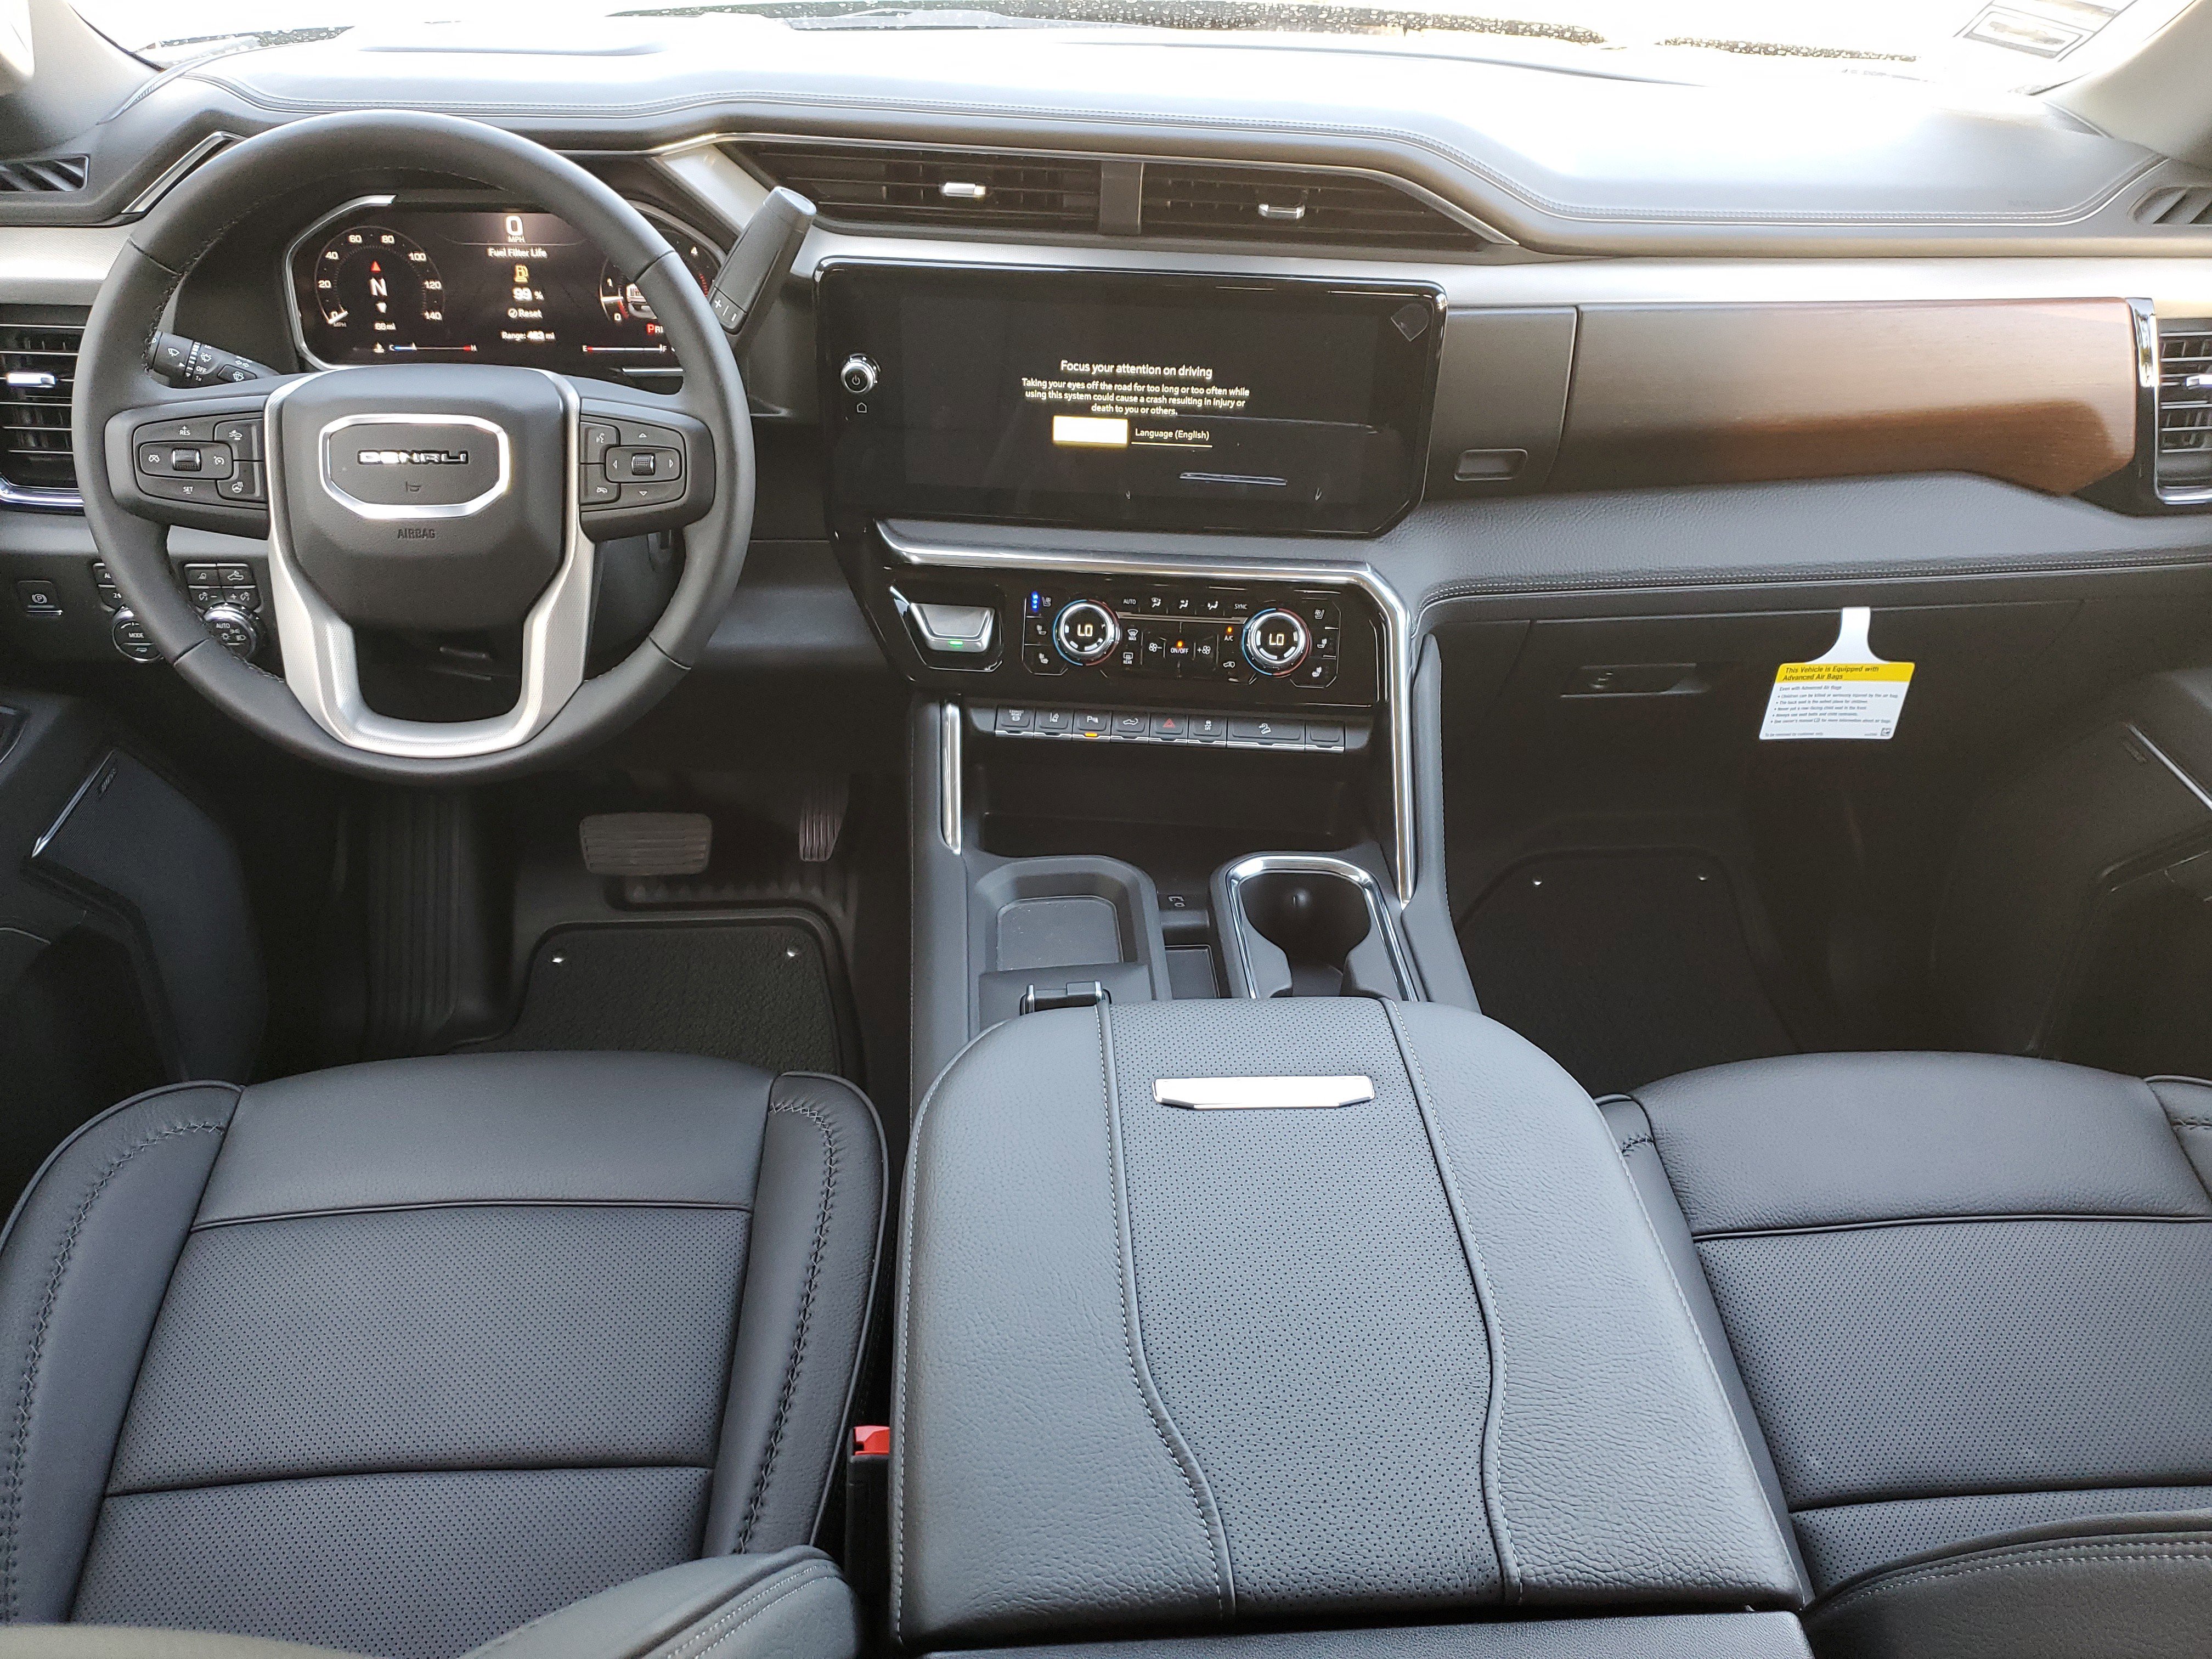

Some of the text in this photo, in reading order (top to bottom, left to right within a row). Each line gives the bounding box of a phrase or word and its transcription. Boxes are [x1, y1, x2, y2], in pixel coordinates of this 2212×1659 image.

[506, 215, 524, 236] 0
[348, 235, 362, 243] 60
[380, 235, 394, 244] 80
[325, 251, 339, 259] 40
[409, 252, 427, 261] 100
[487, 247, 548, 258] Fuel Filter Life
[691, 247, 697, 256] 4
[318, 280, 332, 289] 20
[370, 277, 387, 296] N
[424, 280, 441, 290] 120
[606, 278, 613, 287] 1
[512, 287, 544, 301] 99 %
[424, 312, 442, 320] 140
[517, 308, 543, 318] Reset
[614, 313, 621, 321] 0
[501, 331, 526, 341] Range:
[195, 365, 207, 374] OFF
[1060, 359, 1212, 379] Focus your attention on driving
[1022, 377, 1047, 389] Taking
[1048, 380, 1066, 389] your
[1067, 381, 1086, 390] eyes
[1086, 381, 1099, 390] off
[1100, 381, 1113, 390] the
[1114, 382, 1132, 391] road
[1133, 382, 1146, 391] for
[1147, 383, 1160, 392] too
[1161, 383, 1180, 394] long
[1190, 386, 1205, 394] too
[1206, 386, 1227, 395] often
[1229, 386, 1250, 396] while
[1025, 390, 1047, 400] using
[1048, 390, 1063, 399] this
[1064, 392, 1092, 402] system
[1093, 393, 1114, 402] could
[1146, 395, 1167, 404] crash
[1169, 396, 1203, 407] resulting
[1204, 397, 1211, 405] in
[1213, 398, 1235, 408] injury
[1091, 403, 1114, 413] death
[1124, 407, 1139, 415] you
[1150, 406, 1178, 415] others.
[1135, 428, 1210, 441] Language (English)
[397, 528, 436, 539] AIRBAG
[1077, 624, 1093, 637] LO
[1269, 634, 1284, 646] LO
